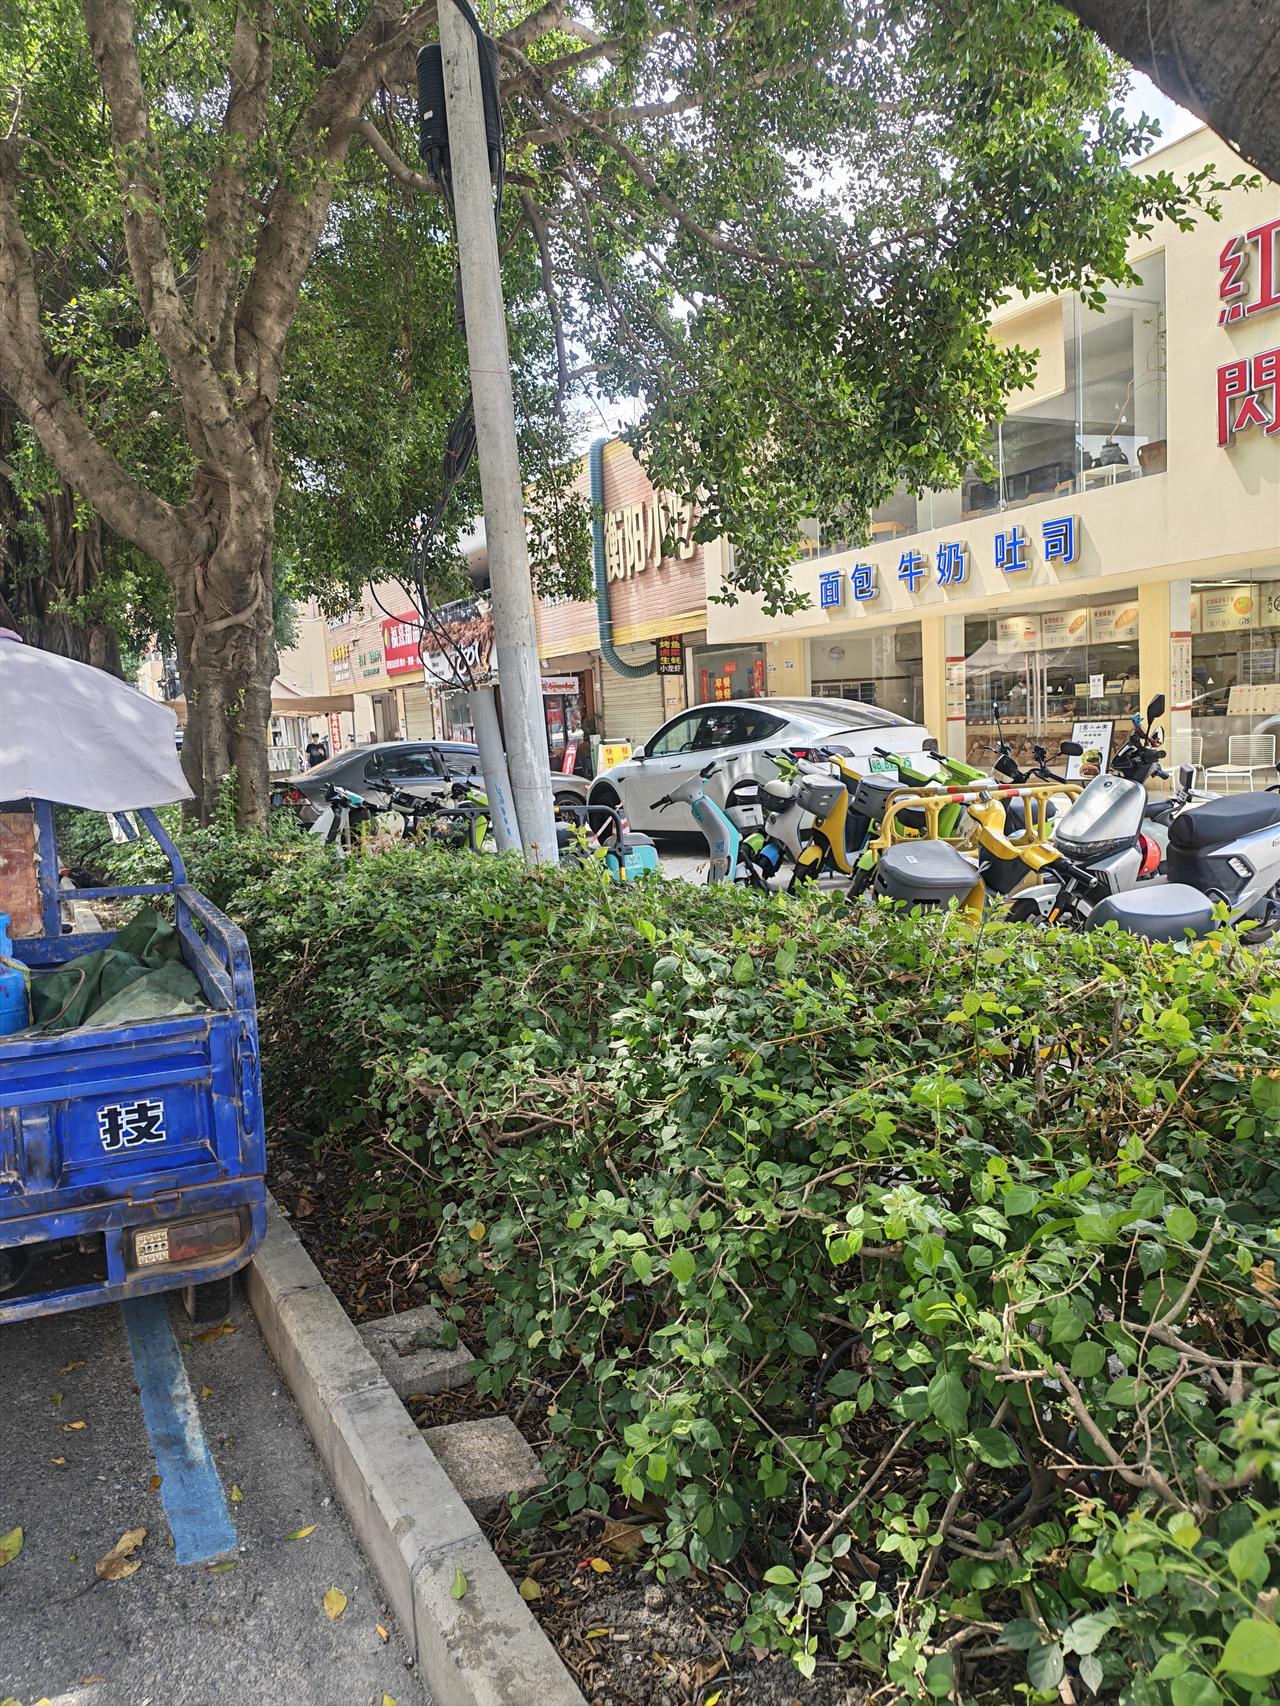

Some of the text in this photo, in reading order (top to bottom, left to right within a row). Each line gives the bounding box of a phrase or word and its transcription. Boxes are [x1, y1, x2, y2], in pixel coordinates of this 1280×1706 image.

[818, 515, 1078, 609] 面包 牛奶 吐司
[660, 664, 682, 673] 小龙虾
[97, 1099, 167, 1151] 技
